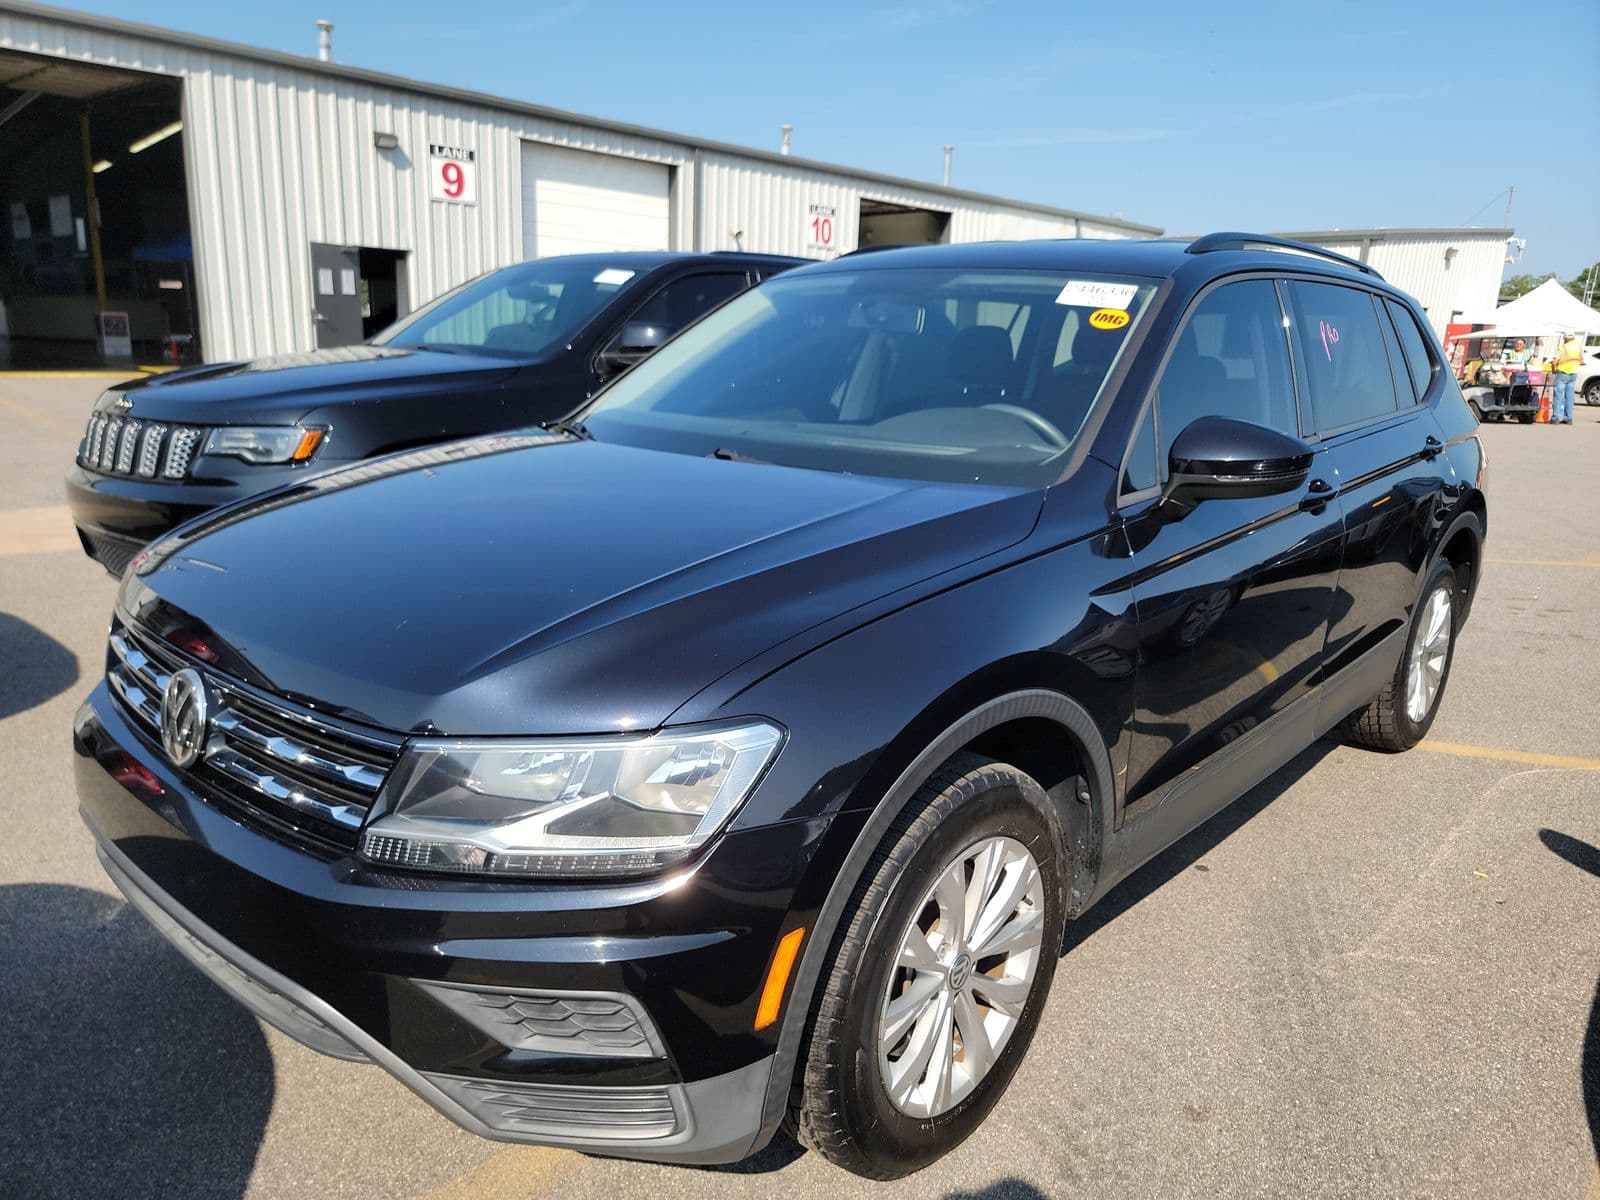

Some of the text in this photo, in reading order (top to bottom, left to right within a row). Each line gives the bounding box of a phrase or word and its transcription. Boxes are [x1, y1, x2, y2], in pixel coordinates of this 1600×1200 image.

[442, 162, 464, 198] 9
[812, 217, 831, 244] 10
[1094, 312, 1125, 325] IMG
